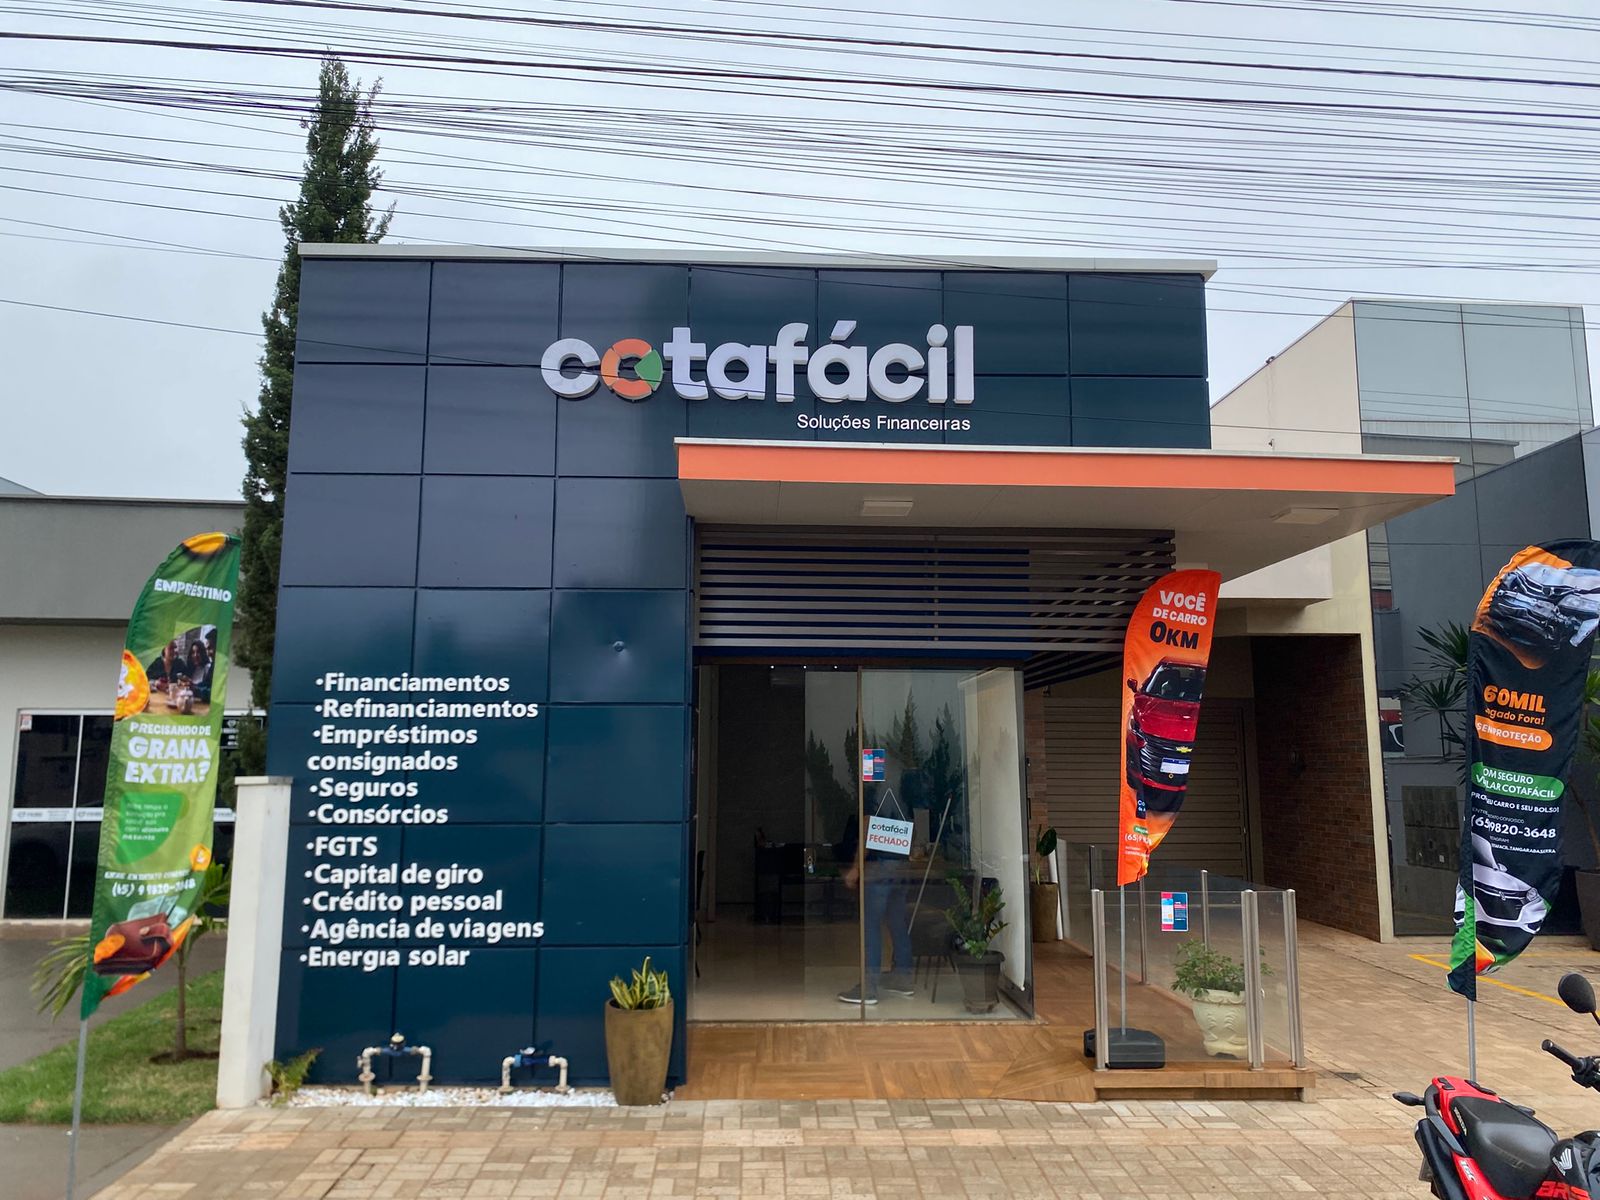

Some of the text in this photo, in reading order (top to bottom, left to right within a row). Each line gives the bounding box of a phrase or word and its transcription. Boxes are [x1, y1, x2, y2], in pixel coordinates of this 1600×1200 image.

[797, 414, 971, 431] Soluções Financeiras
[154, 578, 232, 603] EMPRÉSTIMO
[1160, 590, 1206, 612] VOCÊ
[1152, 607, 1207, 626] DE CARRO
[324, 672, 510, 692] Financiamentos
[322, 698, 539, 718] Refinanciamentos
[130, 722, 198, 735] PRECISANDO
[198, 725, 211, 736] DE
[1518, 713, 1545, 725] Fora!
[320, 724, 478, 748] Empréstimos
[128, 736, 211, 759] GRANA
[125, 761, 211, 784] EXTRA?
[307, 751, 458, 775] consignados
[1498, 772, 1534, 785] SEGURO
[319, 777, 418, 802] Seguros
[1502, 784, 1556, 798] COTAFÁCIL
[317, 804, 449, 824] Consórcios
[871, 823, 908, 835] cotafácil
[315, 836, 378, 857] FGTS
[869, 834, 909, 847] FECHADO
[313, 863, 483, 889] Capital de giro
[312, 890, 503, 916] Crédito pessoal
[310, 917, 544, 944] Agência de viagens
[308, 945, 470, 972] Energia solar
